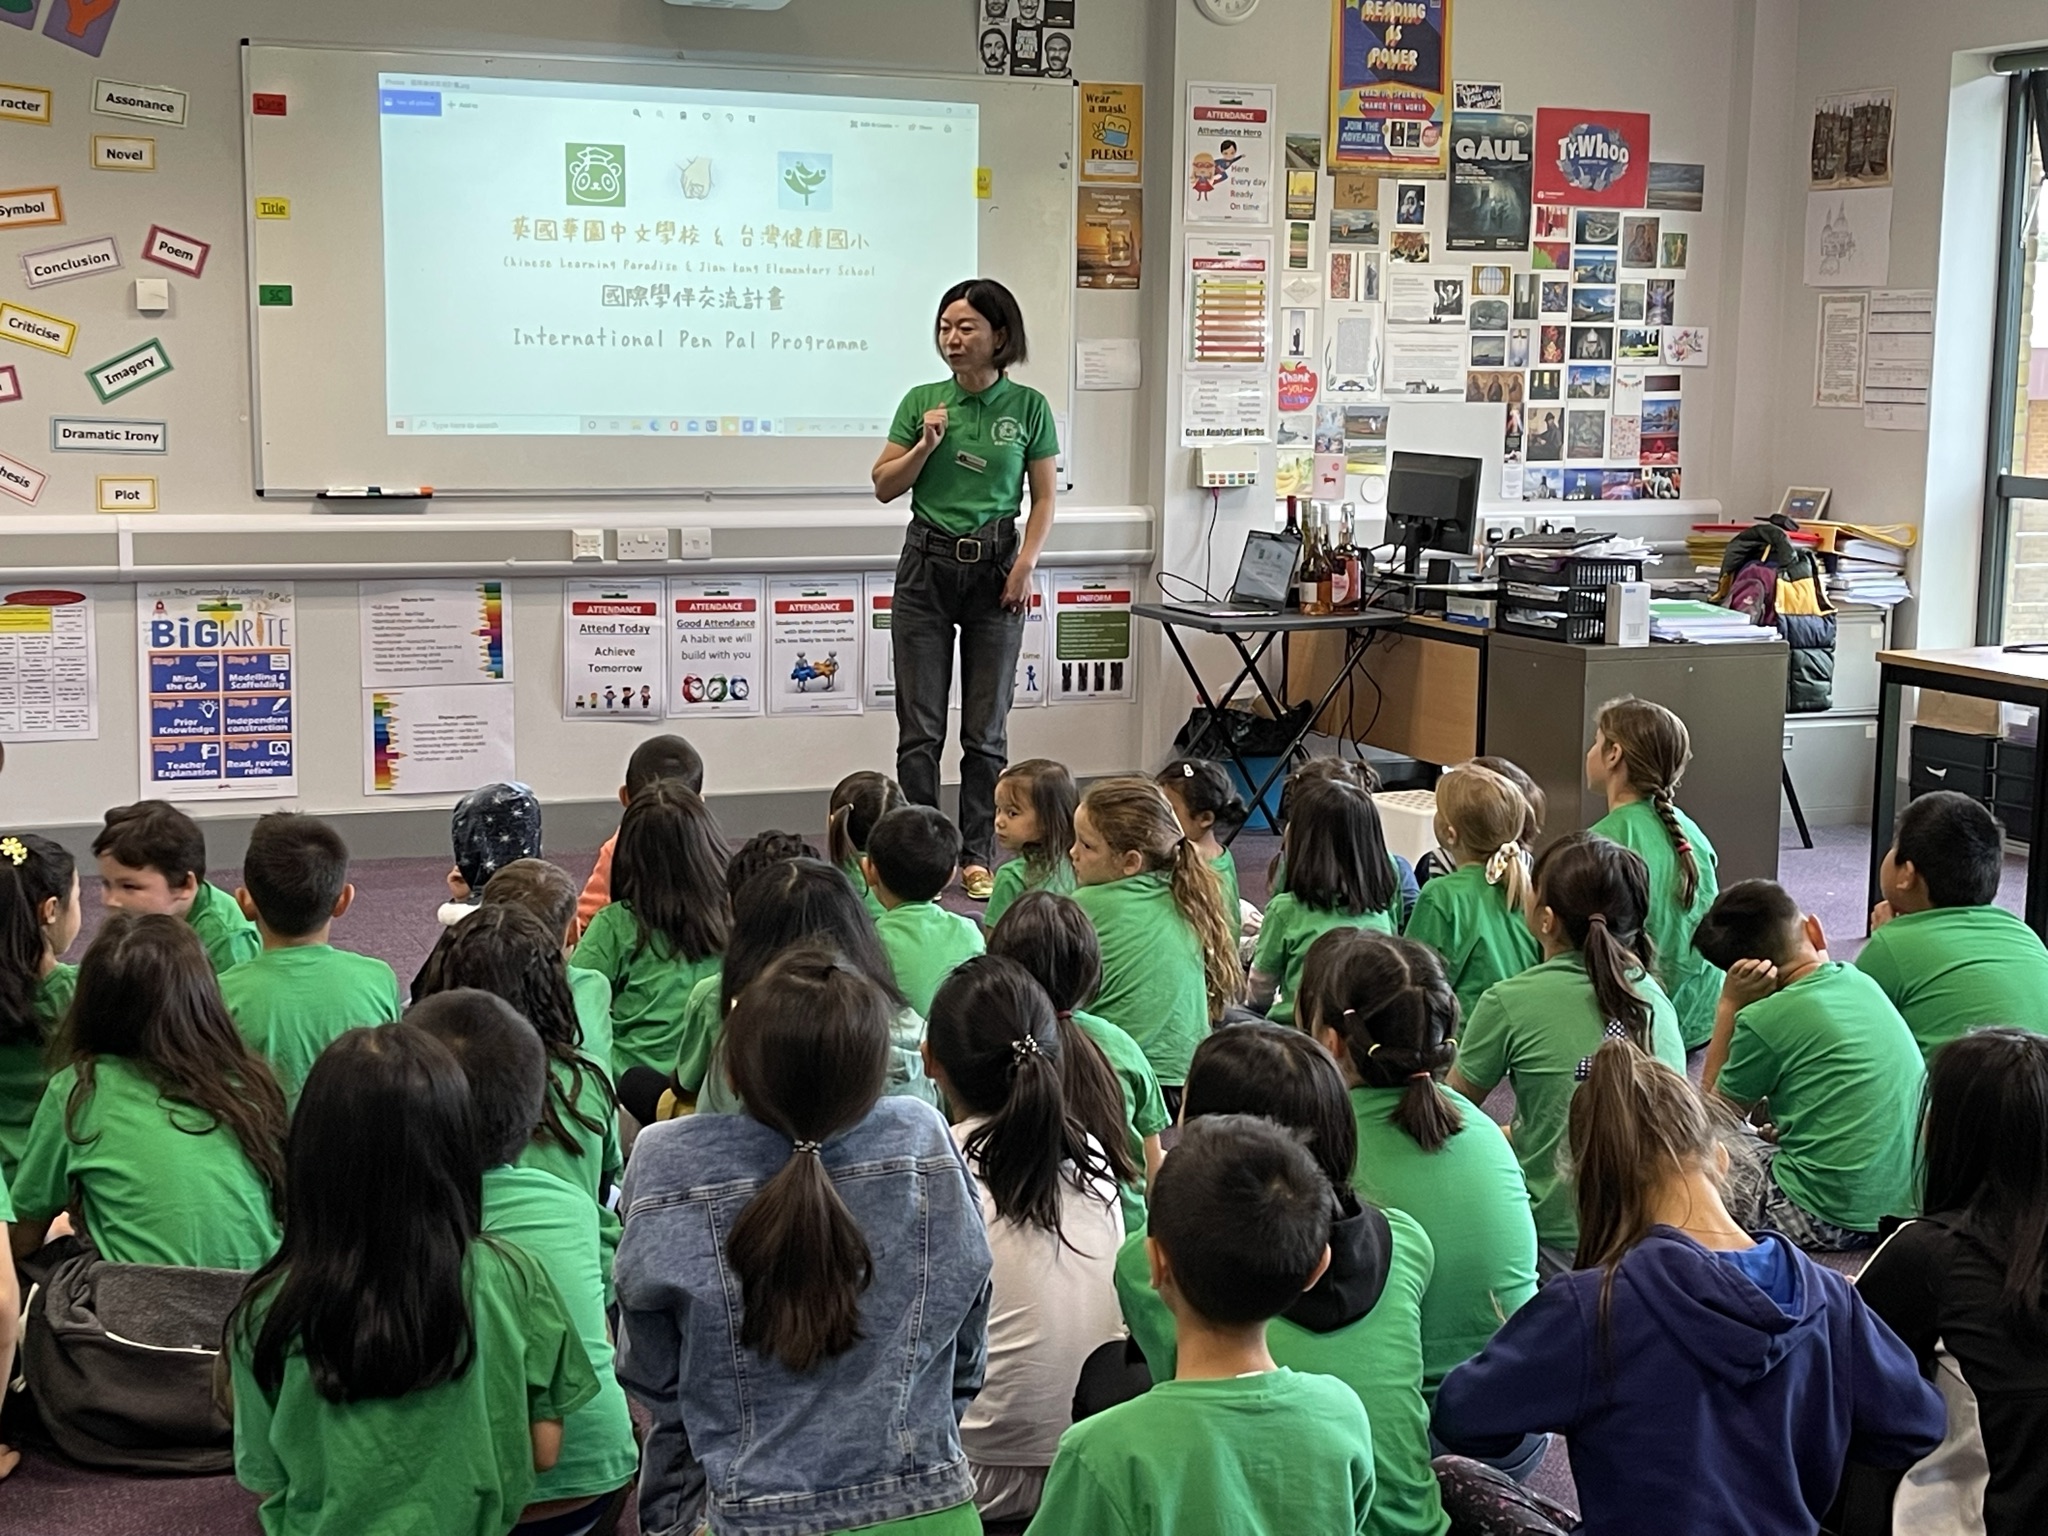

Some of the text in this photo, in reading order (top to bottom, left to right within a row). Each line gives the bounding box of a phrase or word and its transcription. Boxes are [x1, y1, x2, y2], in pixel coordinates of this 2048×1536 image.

[1369, 48, 1418, 68] POWER
[106, 93, 175, 113] Assonance
[1086, 93, 1110, 103] Wear
[1089, 104, 1127, 114] a mask!
[1206, 111, 1254, 120] ATTENDANCE
[1345, 121, 1379, 131] JOIN THE
[1198, 127, 1262, 137] Attendance Hero
[1341, 132, 1380, 143] MOVEMENT
[106, 149, 143, 160] Novel
[1091, 149, 1133, 160] PLEASE!
[1456, 138, 1529, 161] GAUL
[1231, 165, 1249, 173] Here
[1231, 178, 1267, 187] Every day
[1230, 190, 1253, 199] Ready
[0, 202, 45, 217] Symbol
[261, 202, 287, 215] Title
[1230, 203, 1260, 211] On time
[741, 224, 870, 249] 台灣健康國小
[159, 241, 194, 261] Poem
[34, 253, 111, 277] Conclusion
[503, 256, 552, 268] Chinese
[560, 257, 616, 270] Learning
[624, 259, 678, 272] Paradise
[699, 262, 726, 273] Jian
[766, 263, 830, 276] Elementary
[838, 265, 875, 277] School
[9, 317, 61, 342] Criticise
[514, 325, 869, 353] International Pen Pal Programme
[104, 355, 155, 385] Imagery
[1280, 371, 1310, 384] Thank
[1287, 385, 1303, 396] you
[62, 429, 159, 444] Dramatic Irony
[1186, 428, 1265, 437] Great Analytical Verbs
[115, 490, 140, 500] Plot
[231, 588, 264, 597] Academy
[1076, 594, 1112, 602] UNIFORM
[587, 606, 641, 614] ATTENDANCE
[689, 602, 743, 611] ATTENDANCE
[788, 603, 840, 612] ATTENDANCE
[676, 618, 755, 629] Good Attendance
[220, 611, 291, 647] WRITE
[580, 623, 650, 635] Attend Today
[680, 633, 752, 643] A habit we will
[595, 647, 636, 656] Achieve
[681, 651, 751, 661] build with you
[588, 663, 643, 673] Tomorrow
[229, 673, 286, 682] Modelling &
[184, 682, 207, 690] GAP
[230, 681, 285, 690] Scaffolding
[174, 719, 198, 727] Prior
[227, 717, 289, 726] Independent
[159, 726, 216, 735] Knowledge
[227, 724, 288, 733] construction
[167, 761, 206, 770] Teacher
[227, 759, 290, 769] Read, review,
[158, 769, 218, 779] Explanation
[244, 767, 273, 775] refine
